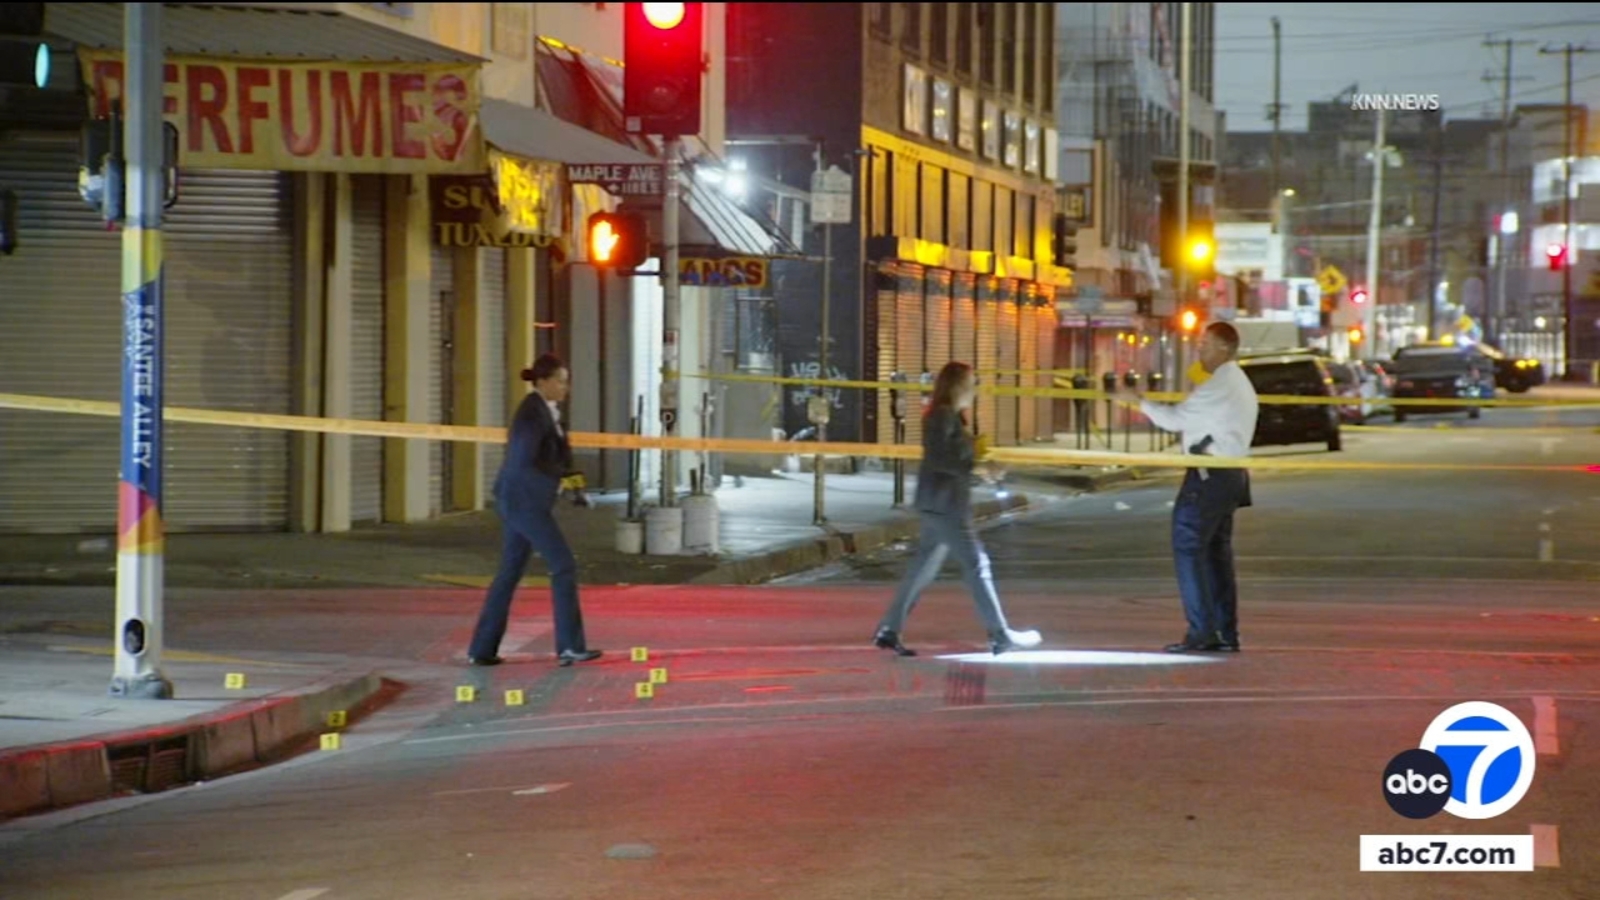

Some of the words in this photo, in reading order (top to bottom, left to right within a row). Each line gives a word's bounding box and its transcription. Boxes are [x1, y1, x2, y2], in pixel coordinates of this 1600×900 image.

[569, 165, 621, 181] MAPLE
[628, 165, 661, 181] AVE
[133, 318, 155, 397] SANTEE
[132, 401, 152, 468] ALLEY
